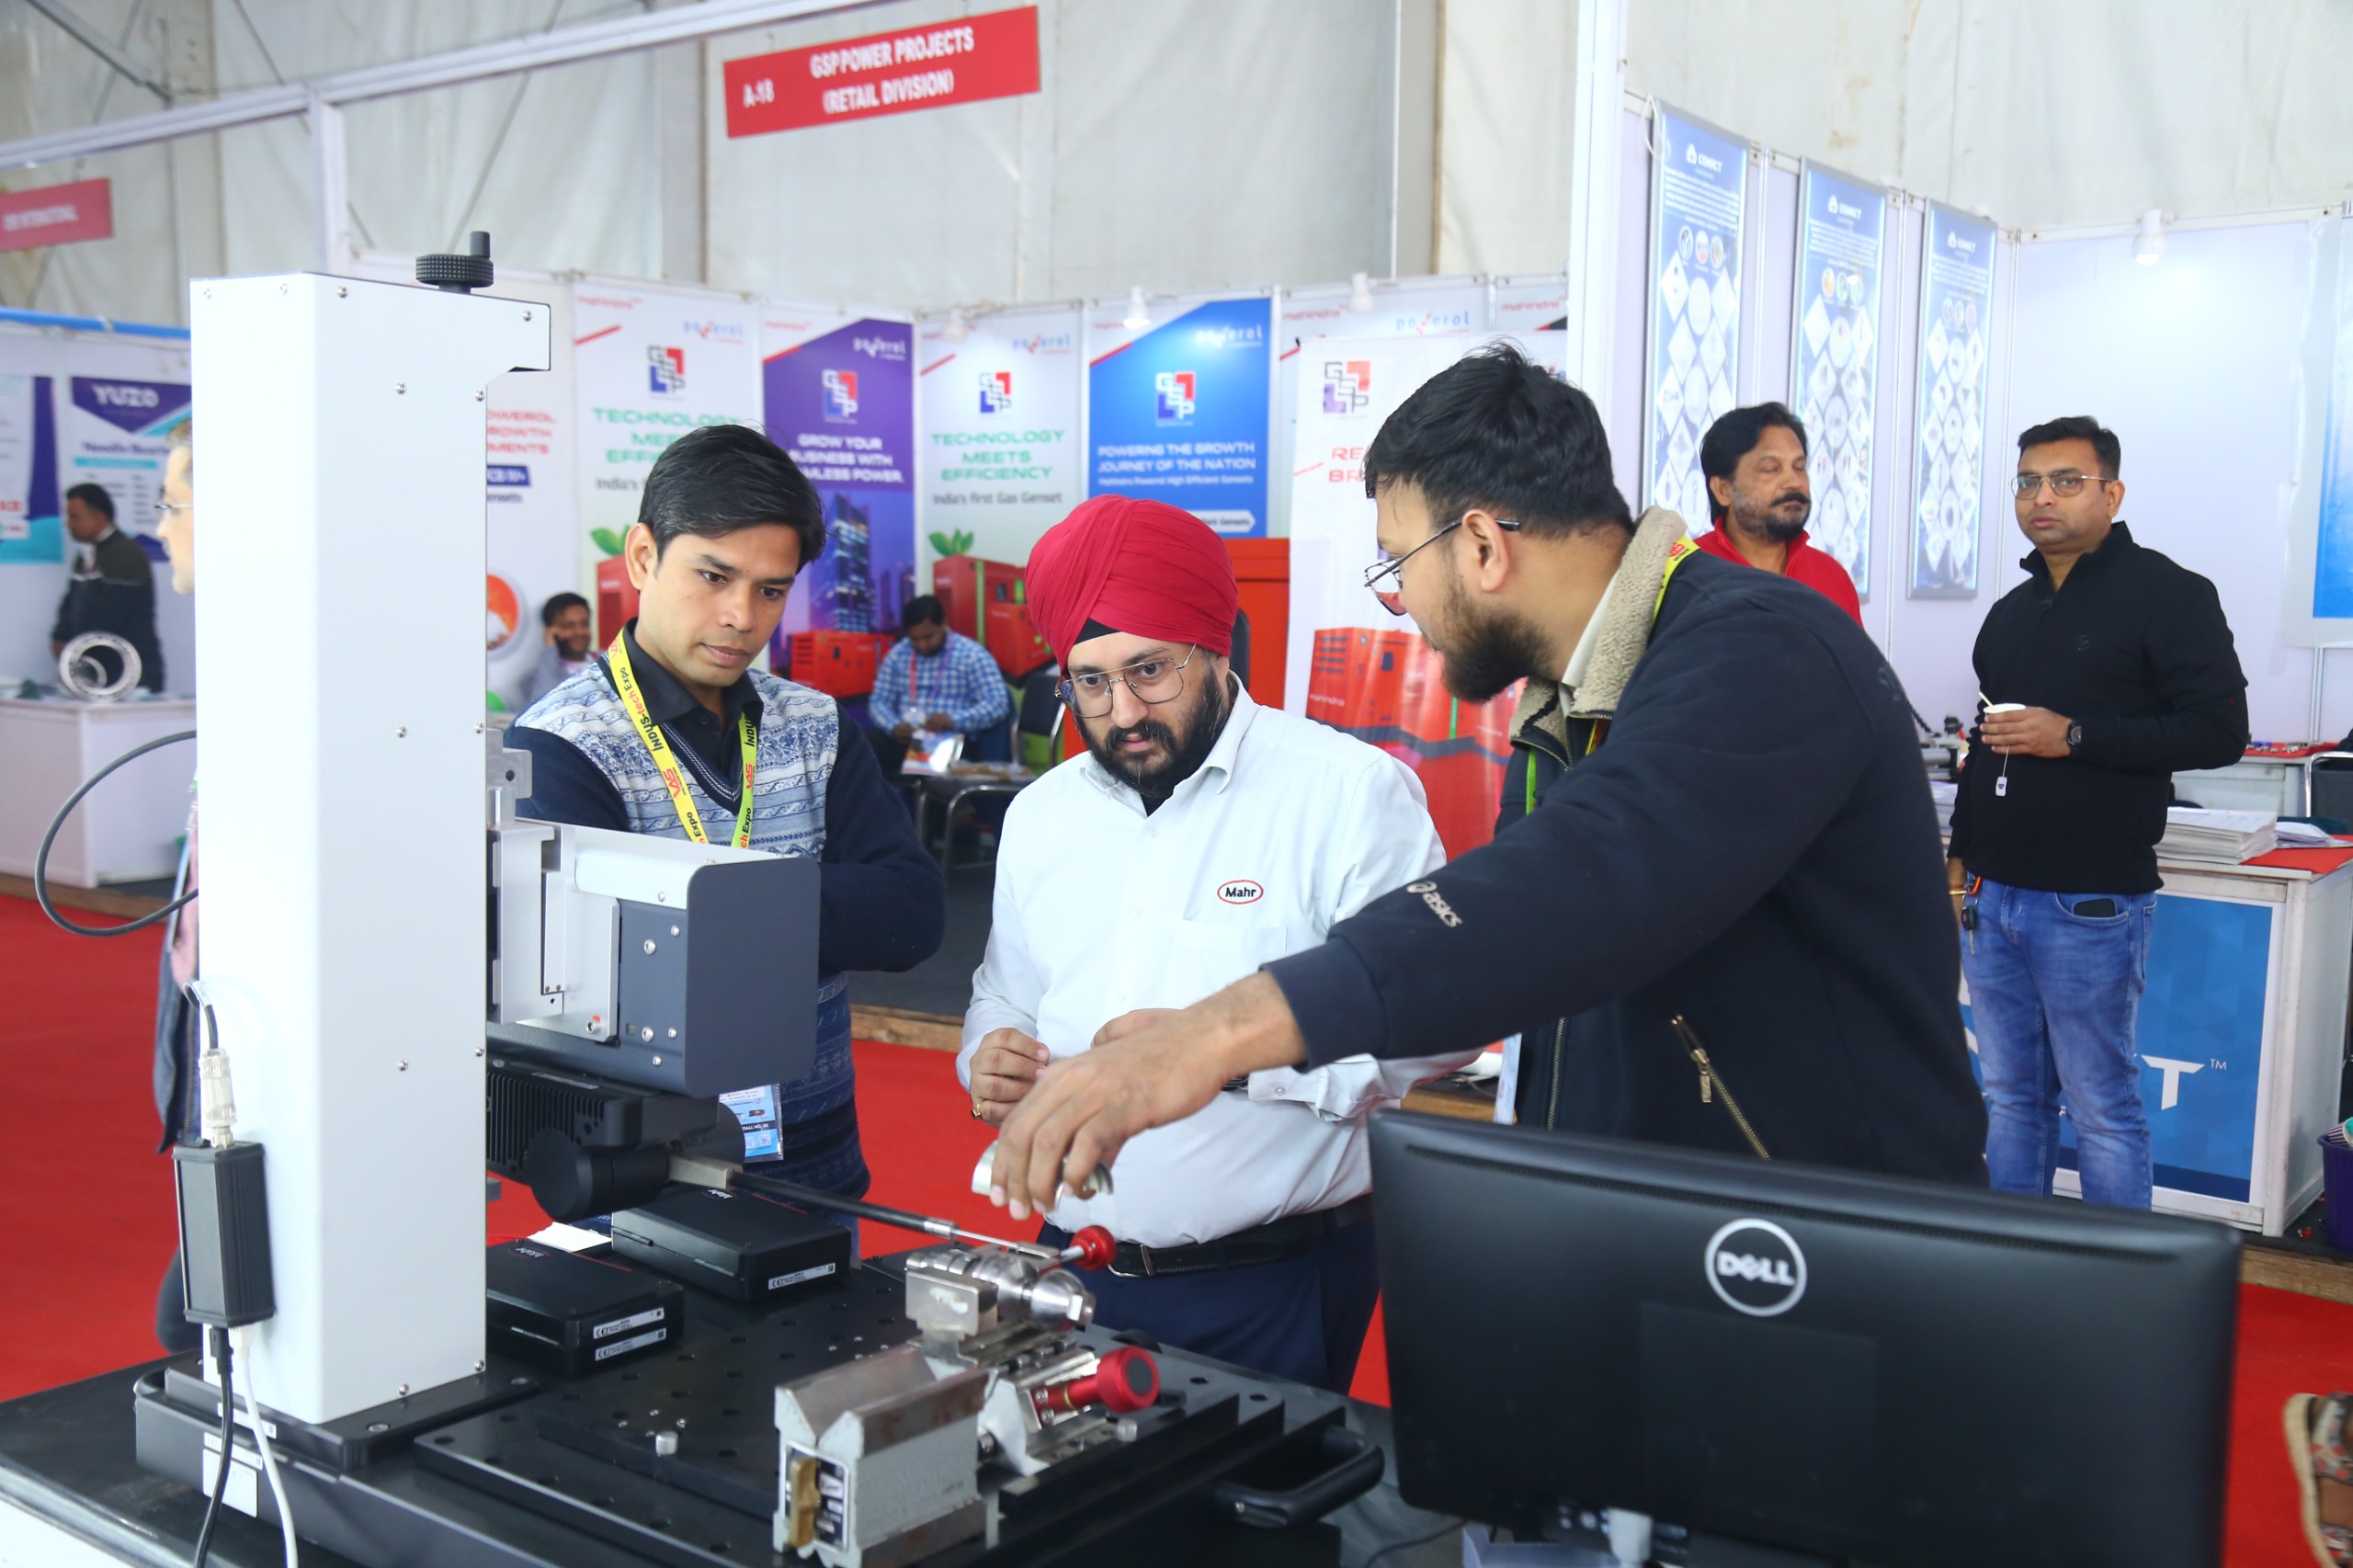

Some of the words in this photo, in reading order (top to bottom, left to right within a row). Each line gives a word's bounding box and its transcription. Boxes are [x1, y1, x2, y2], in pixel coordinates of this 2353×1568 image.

[840, 42, 893, 73] POWER
[894, 26, 974, 64] PROJECTS
[743, 78, 775, 108] A-18
[823, 83, 880, 115] (RETAIL
[881, 68, 955, 106] DIVISION)
[631, 432, 680, 446] MEE
[797, 434, 843, 449] GROW
[844, 436, 882, 450] YOUR
[931, 430, 1065, 446] TECHNOLOGY
[962, 450, 1032, 464] MEETS
[1097, 444, 1165, 458] POWERING
[1166, 443, 1192, 456] THE
[1196, 441, 1256, 455] GROWTH
[856, 453, 893, 466] WITH
[1097, 460, 1155, 473] JOURNEY
[1156, 459, 1174, 472] OF
[1176, 458, 1202, 471] THE
[1204, 457, 1256, 470] NATION
[940, 466, 1053, 481] EFFICIENCY
[933, 492, 968, 505] India's
[970, 492, 994, 505] first
[996, 492, 1019, 505] Gas
[1021, 492, 1063, 505] Genset
[620, 667, 632, 691] Expo
[687, 812, 701, 837] Expo
[742, 808, 752, 833] Expo
[1225, 886, 1256, 898] Mahr
[1717, 1250, 1795, 1287] DELL
